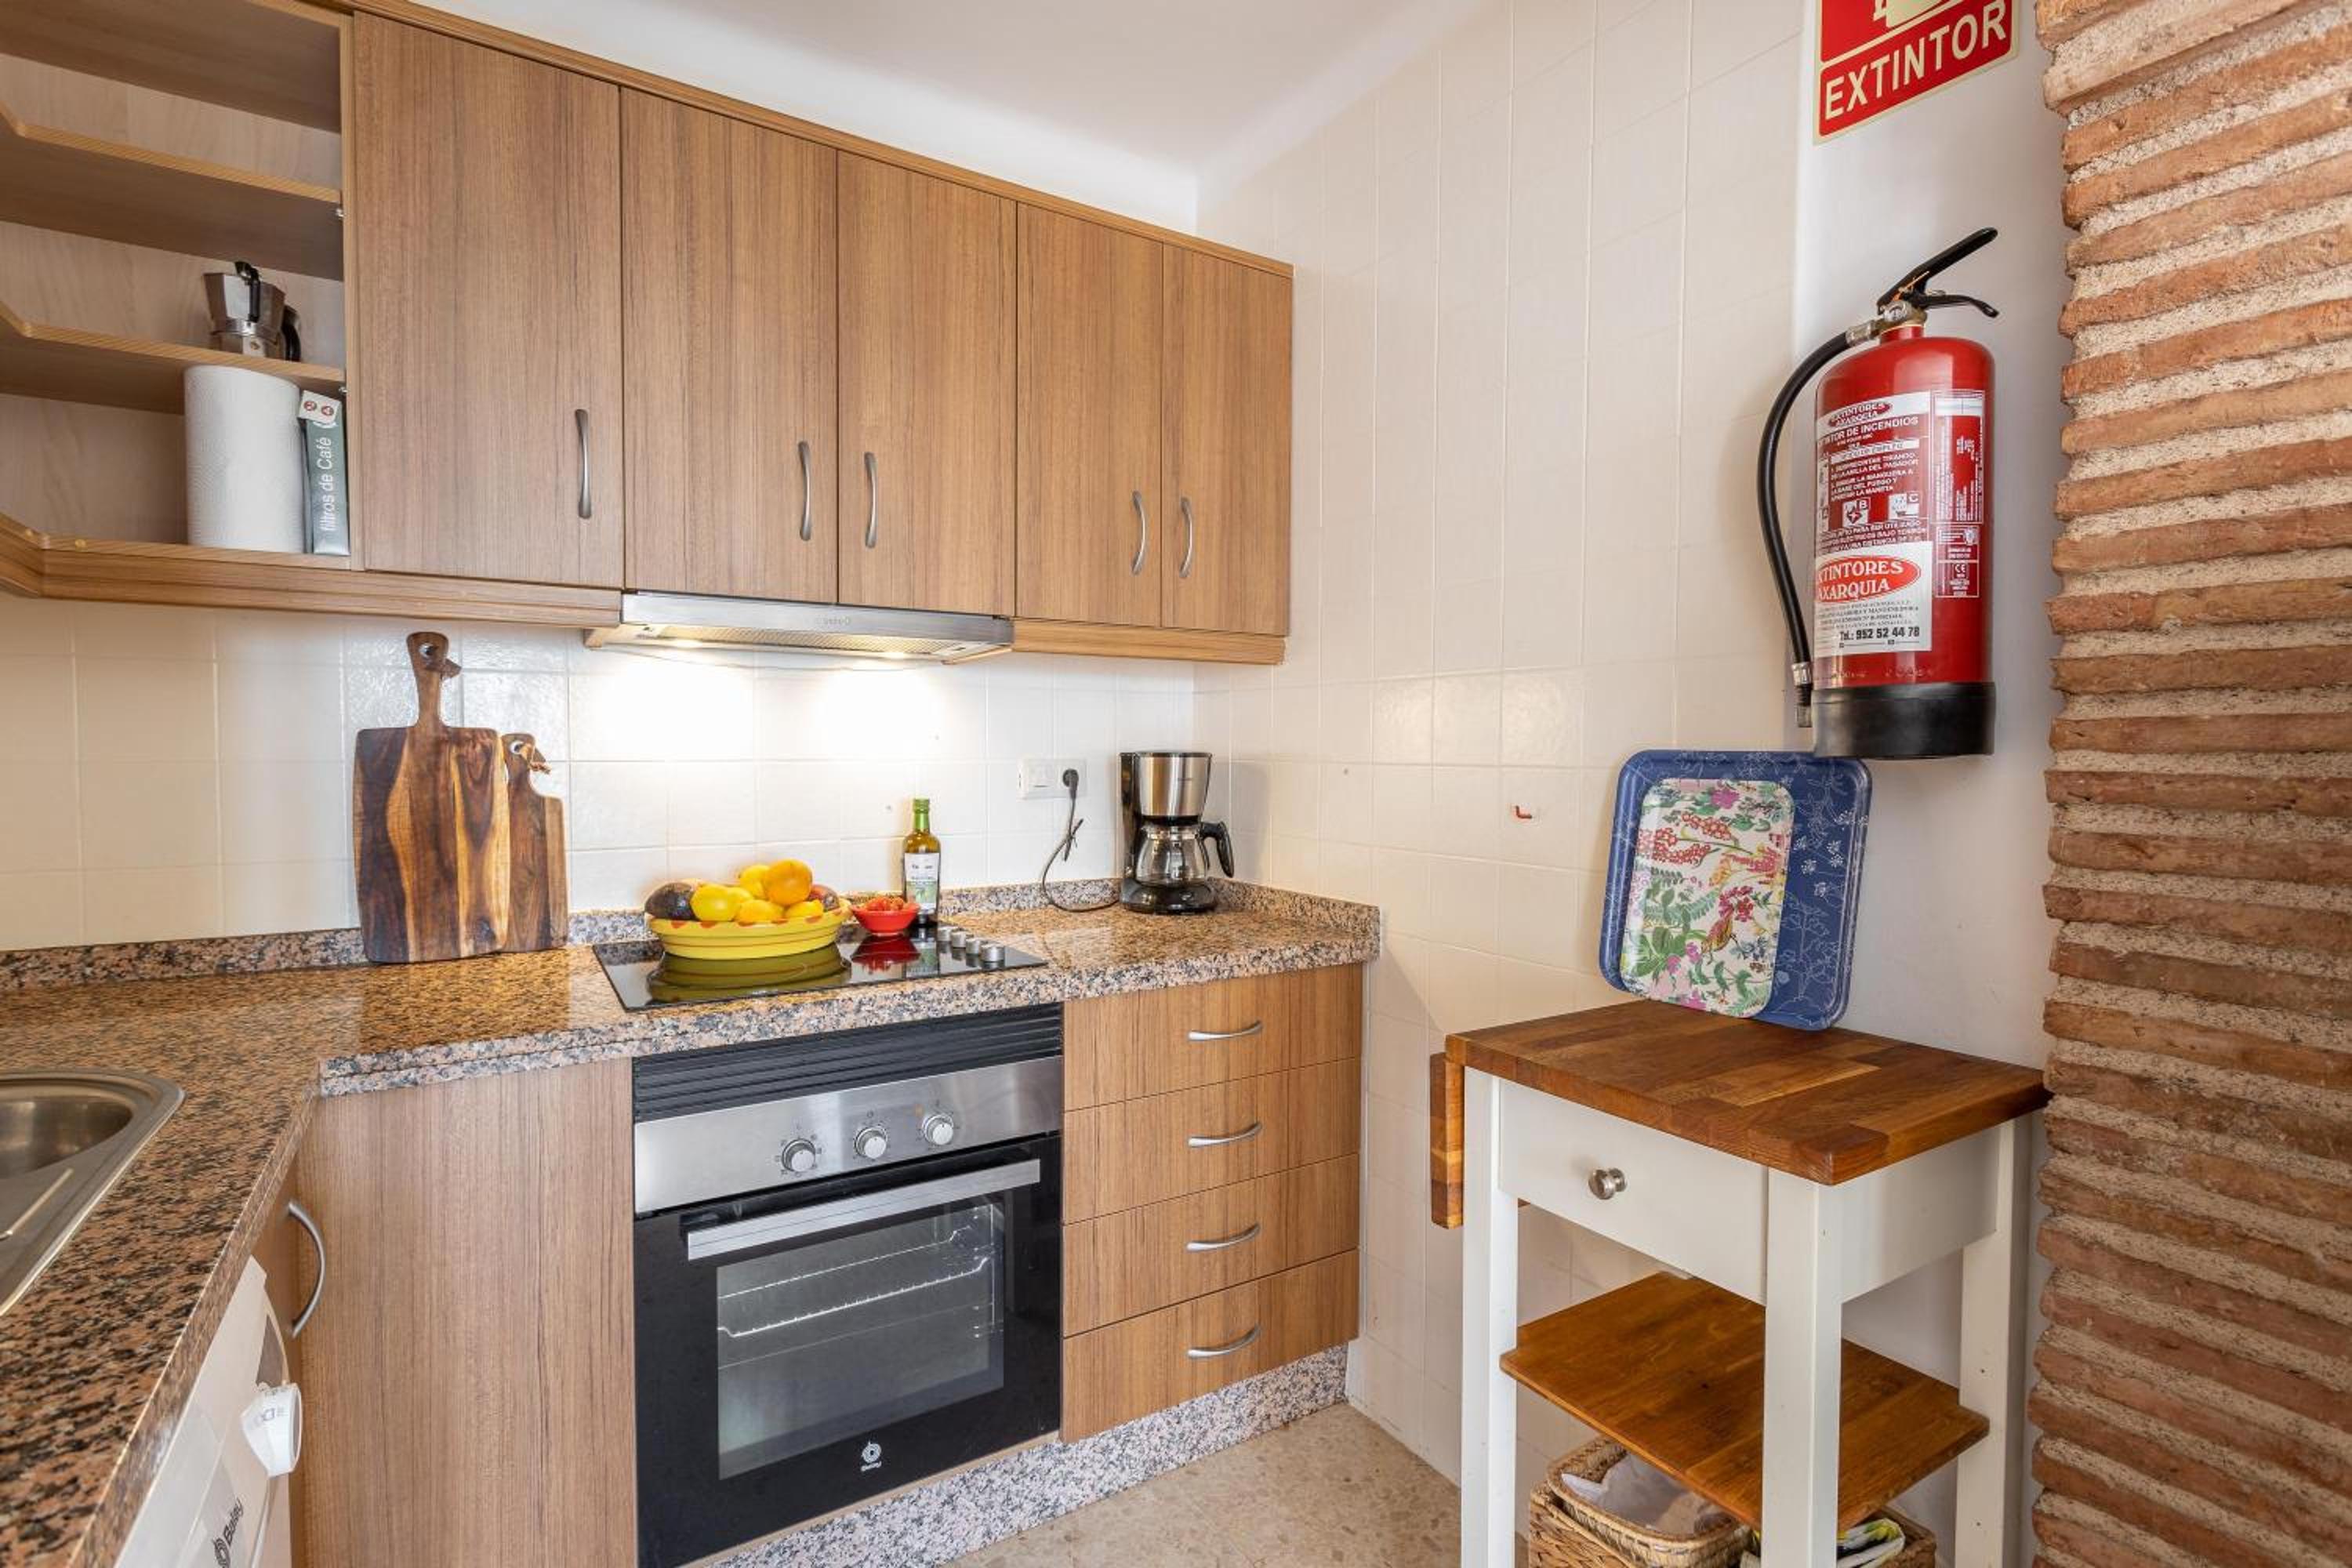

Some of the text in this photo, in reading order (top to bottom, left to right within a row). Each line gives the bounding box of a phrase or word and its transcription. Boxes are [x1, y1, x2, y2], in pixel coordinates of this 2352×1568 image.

[1824, 2, 2006, 121] EXTINTOR
[1846, 426, 1859, 437] DE
[1860, 416, 1919, 434] INCENDIOS
[316, 436, 333, 470] Café
[318, 473, 334, 492] de
[1859, 501, 1868, 510] B
[1908, 493, 1919, 503] C
[1856, 628, 1874, 641] 952
[1876, 627, 1889, 638] 52
[1891, 626, 1905, 637] 44
[1907, 626, 1920, 637] 78
